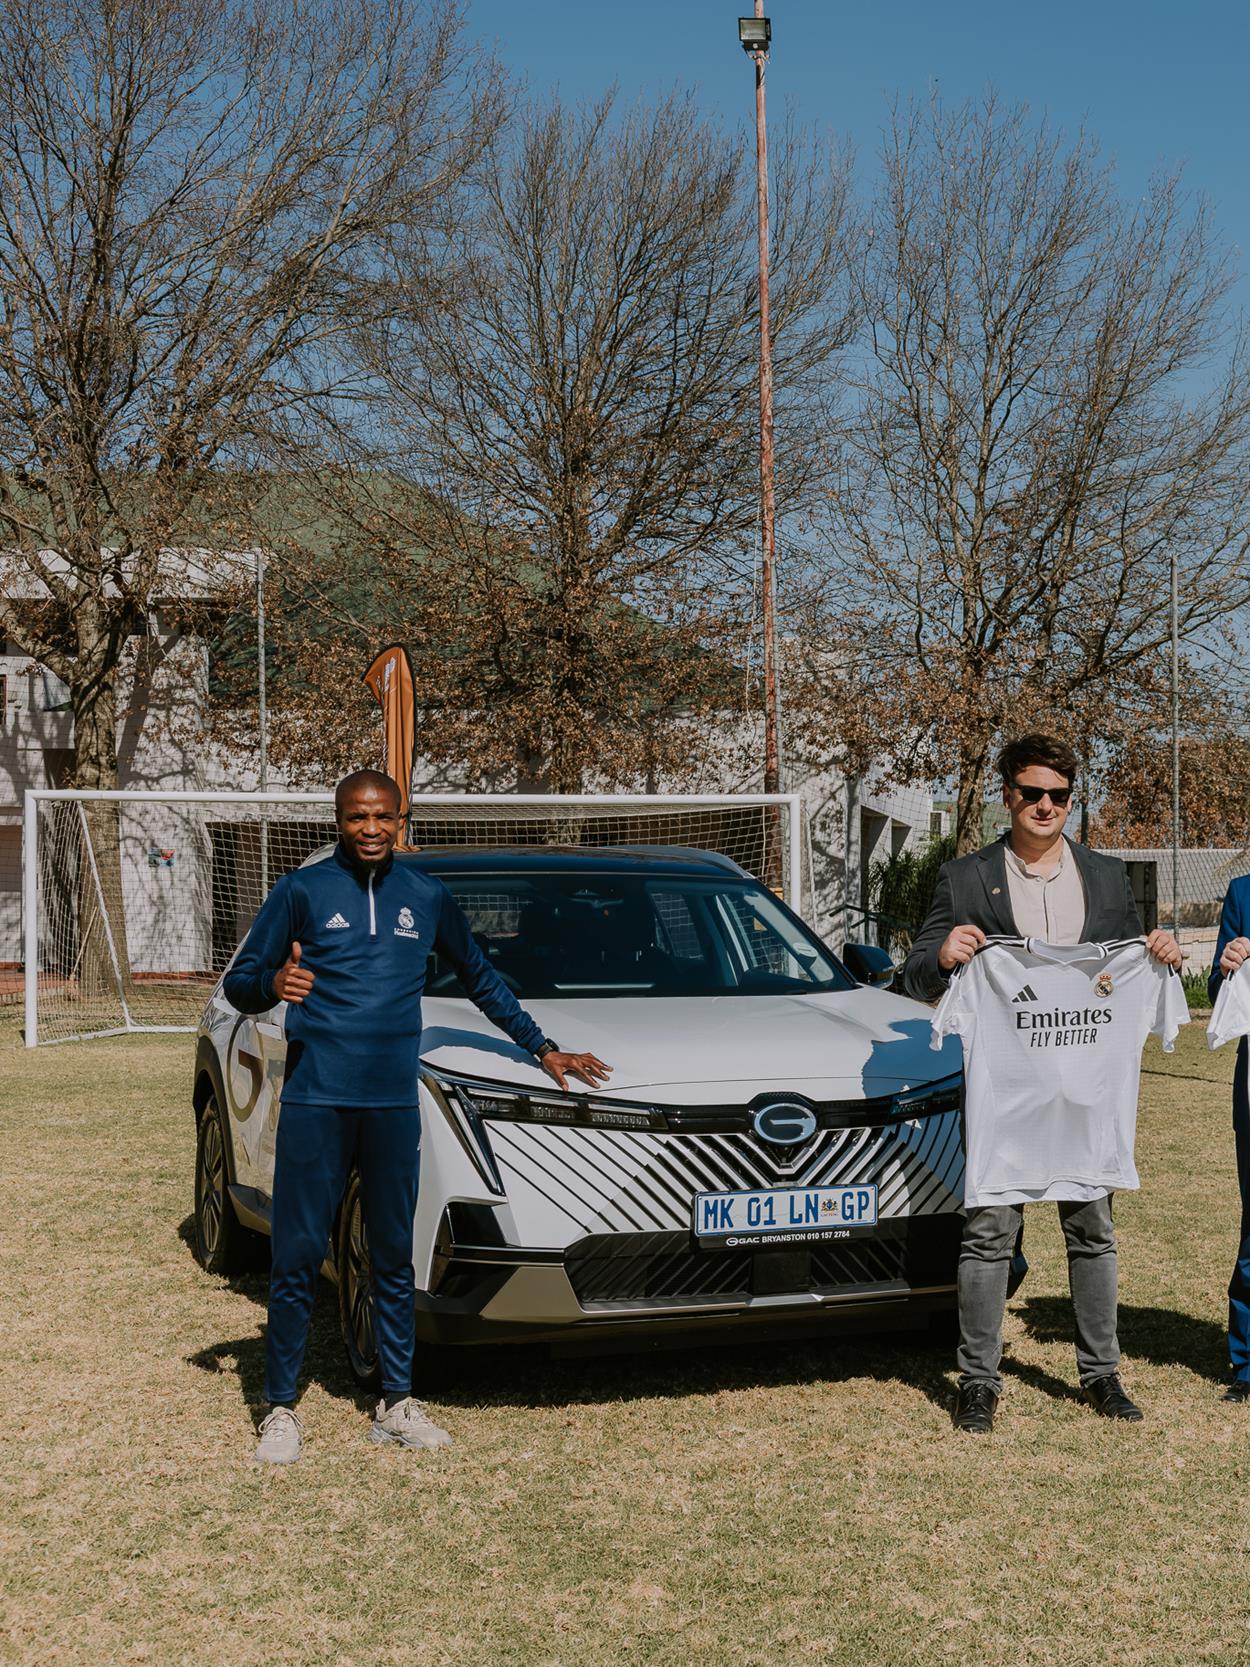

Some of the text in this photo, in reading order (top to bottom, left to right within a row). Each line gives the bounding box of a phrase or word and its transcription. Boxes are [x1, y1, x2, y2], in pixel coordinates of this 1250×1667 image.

[1016, 1007, 1112, 1030] Emirates
[1030, 1028, 1098, 1048] FLY BETTER
[704, 1190, 870, 1230] MK 01 LN GP
[761, 1233, 806, 1244] BRYANSTON
[806, 1232, 820, 1241] 010
[821, 1231, 833, 1240] 157
[834, 1230, 850, 1239] 2784
